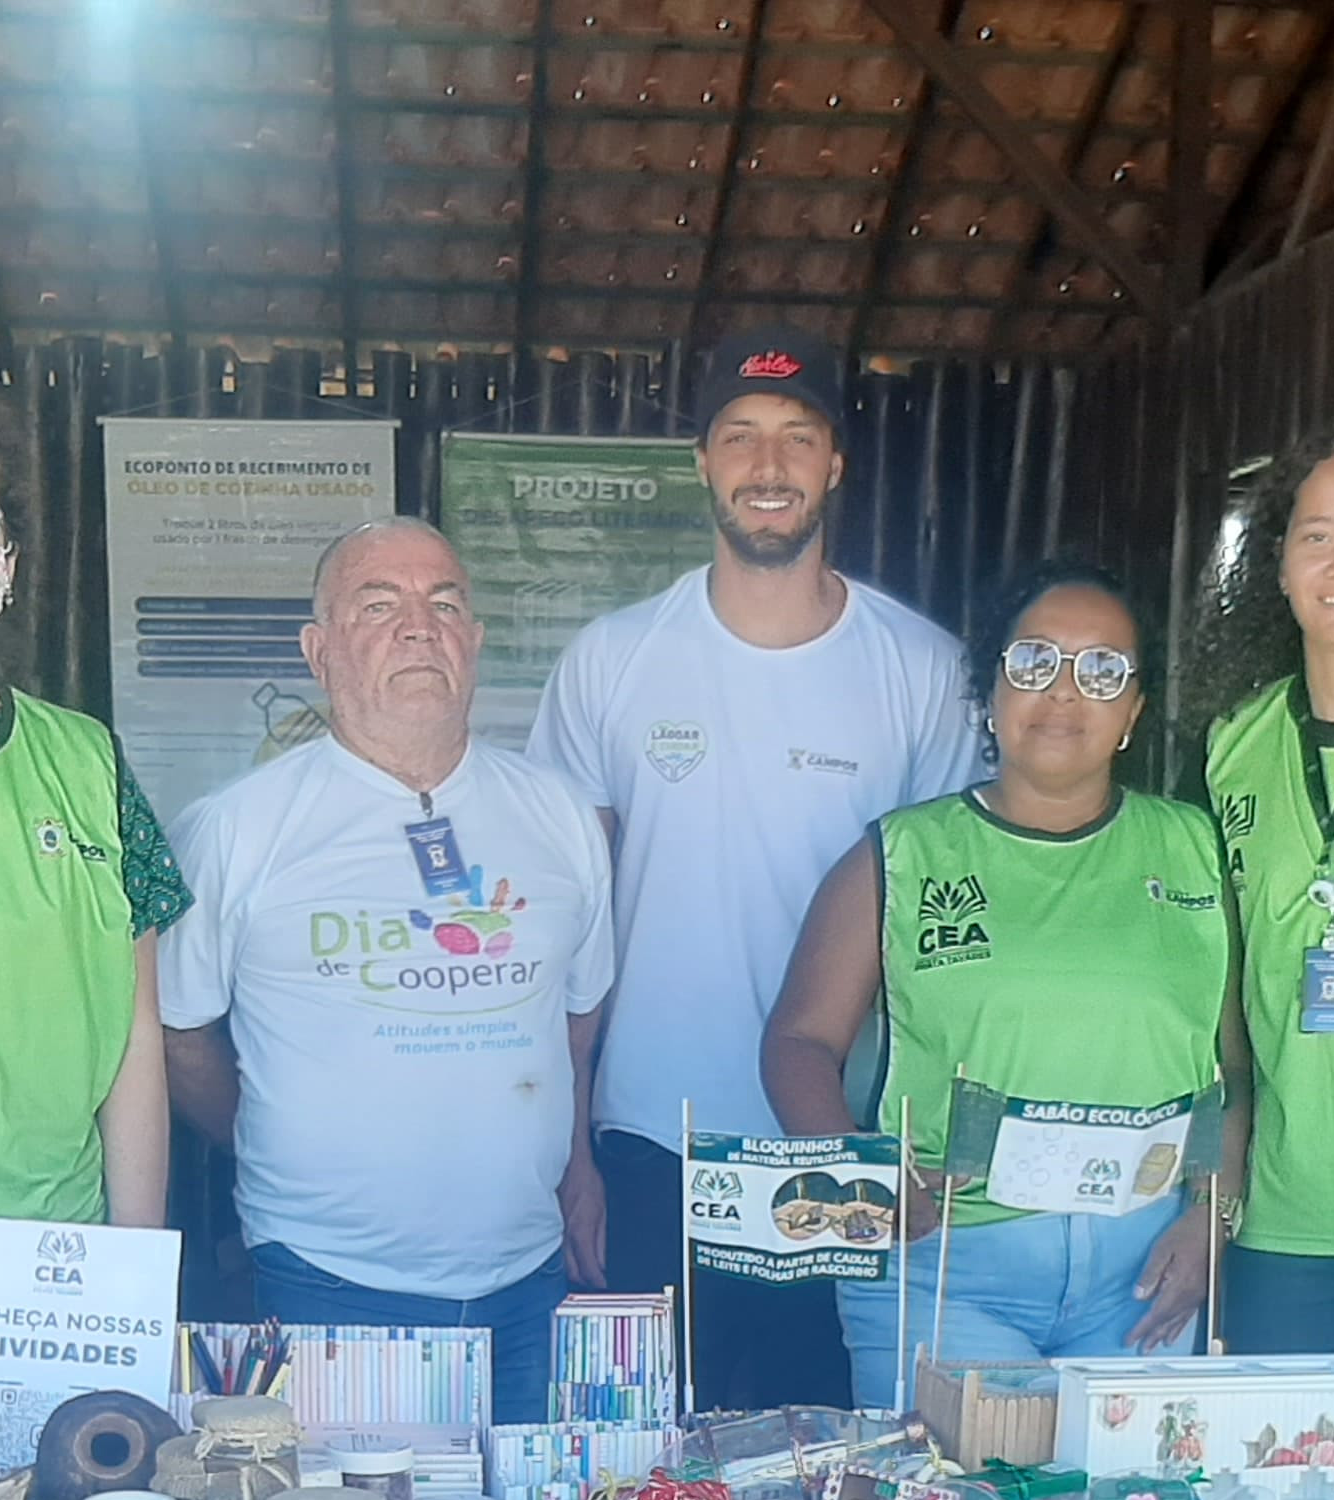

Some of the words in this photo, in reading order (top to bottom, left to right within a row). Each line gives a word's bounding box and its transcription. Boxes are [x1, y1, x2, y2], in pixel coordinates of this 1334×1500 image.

[124, 460, 211, 475] ECOPONTO
[215, 461, 234, 475] DE
[238, 461, 349, 476] RECEBIMENTO
[352, 462, 372, 475] DE
[127, 478, 179, 496] ÓLEO
[184, 480, 209, 496] DE
[308, 481, 375, 497] USADO
[515, 476, 658, 501] PROJETO
[309, 910, 412, 957] Dia
[918, 922, 990, 956] CEA
[316, 959, 351, 978] de
[359, 958, 544, 996] Cooperar
[373, 1023, 452, 1039] Atitudes
[456, 1020, 518, 1040] simples
[465, 1039, 477, 1051] o
[480, 1032, 535, 1049] mundo
[1022, 1101, 1085, 1122] SABÃO
[741, 1137, 844, 1156] BLOQUINHOS
[727, 1151, 742, 1162] DE
[741, 1152, 793, 1166] MATERIAL
[1076, 1183, 1116, 1197] CEA
[690, 1201, 742, 1221] CEA
[696, 1245, 766, 1266] PRODUZIDO
[766, 1257, 776, 1268] A
[776, 1254, 815, 1271] PARTIR
[816, 1251, 832, 1263] DE
[833, 1251, 879, 1266] CAIXAS
[34, 1265, 84, 1285] CEA
[696, 1255, 712, 1266] DE
[712, 1258, 742, 1275] LEITE
[742, 1264, 750, 1275] E
[751, 1266, 795, 1282] FOLHAS
[796, 1265, 810, 1277] DE
[811, 1263, 879, 1279] RASCUNHO
[66, 1312, 163, 1338] NOSSAS
